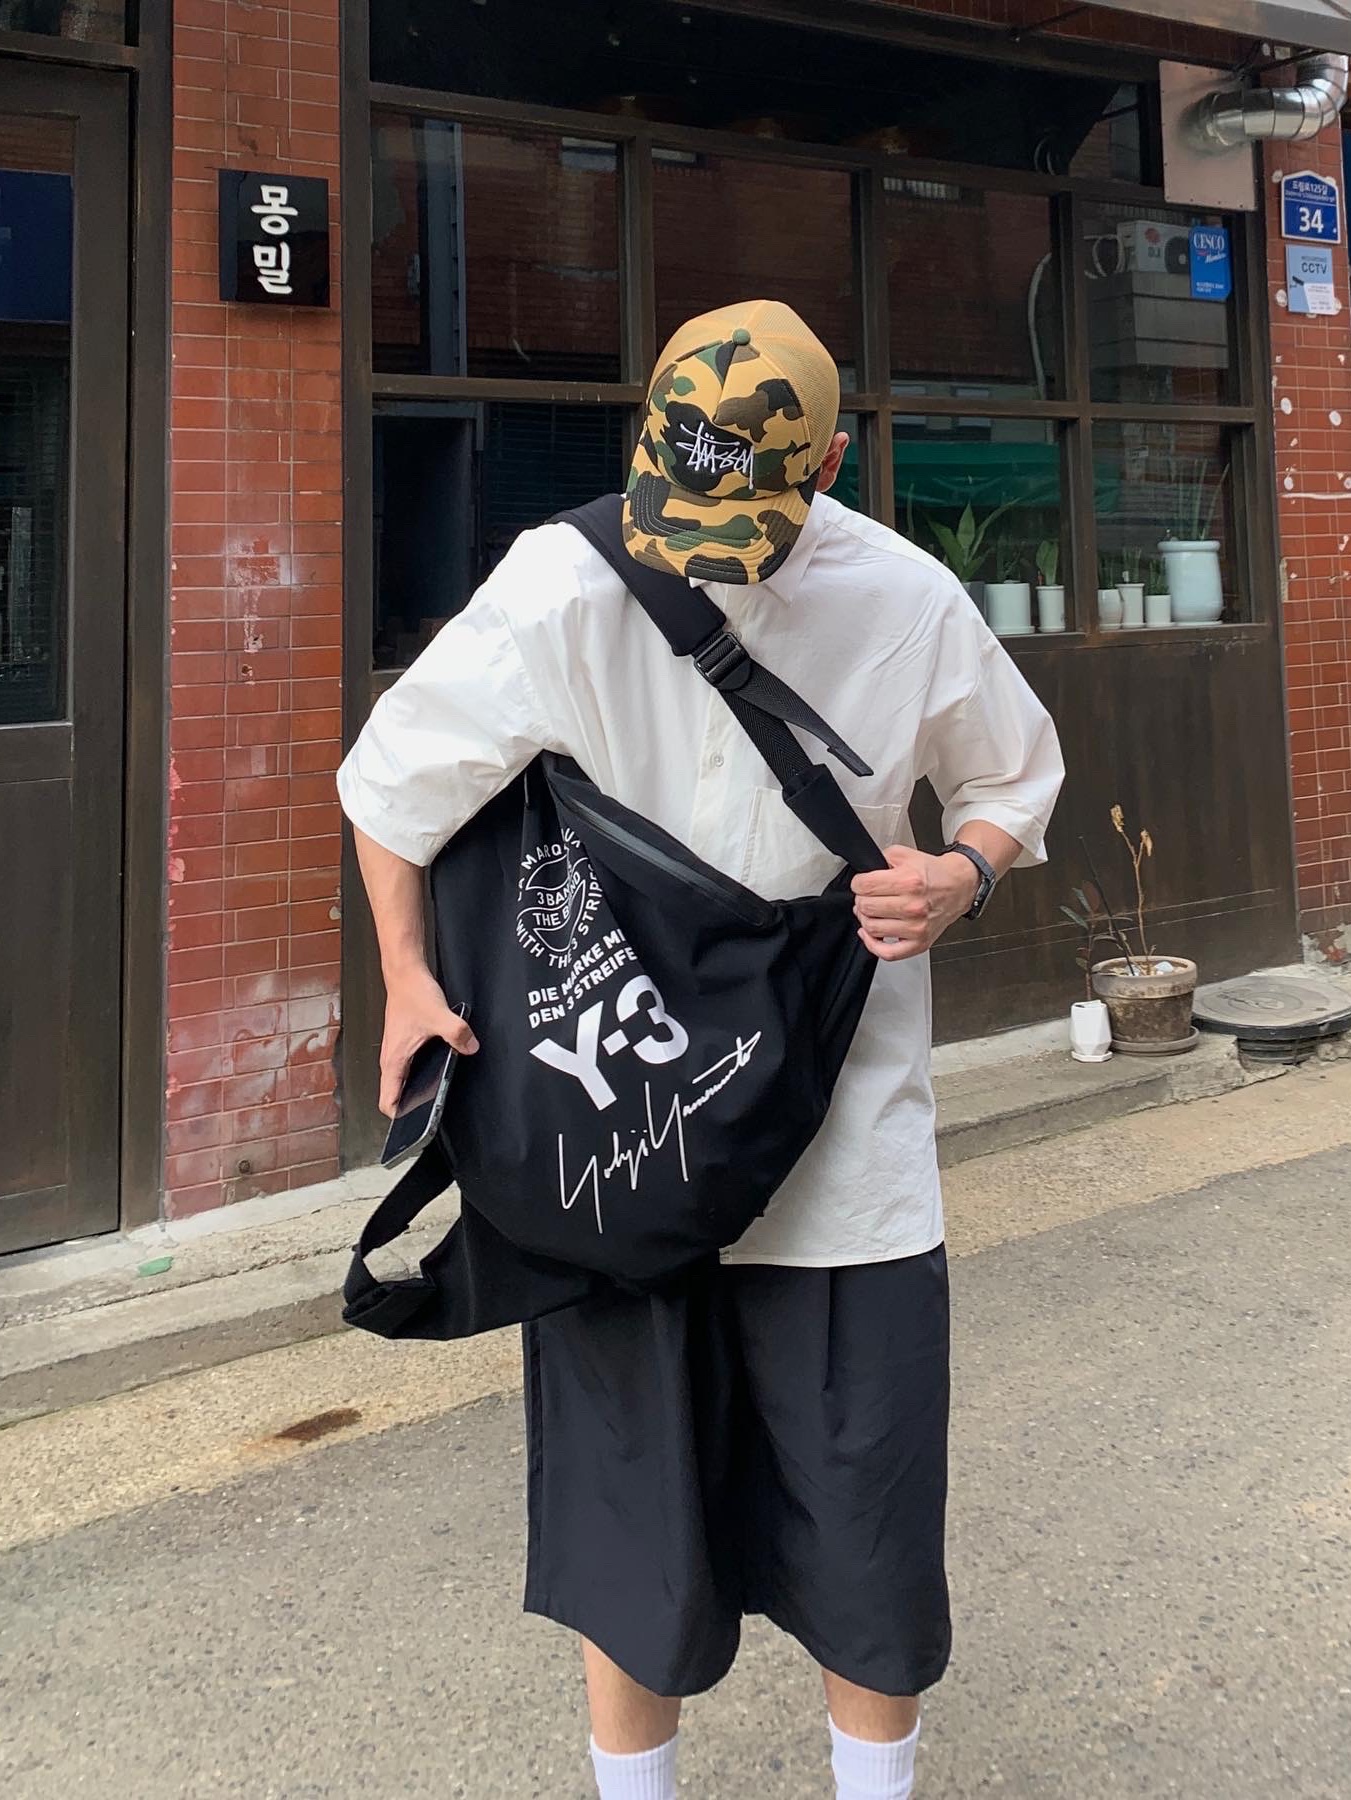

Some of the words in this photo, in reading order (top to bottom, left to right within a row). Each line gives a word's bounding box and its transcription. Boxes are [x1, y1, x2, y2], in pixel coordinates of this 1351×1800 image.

[1299, 207, 1324, 234] 34
[250, 184, 299, 294] 몽밀
[1193, 233, 1225, 251] CESCO
[1301, 262, 1327, 274] CCTV
[532, 911, 561, 926] THE
[516, 918, 545, 958] WITH
[549, 949, 573, 969] THE
[527, 986, 560, 1006] DIE
[561, 942, 605, 996] MARKE
[528, 1003, 566, 1029] DEN
[529, 974, 690, 1112] Y-3
